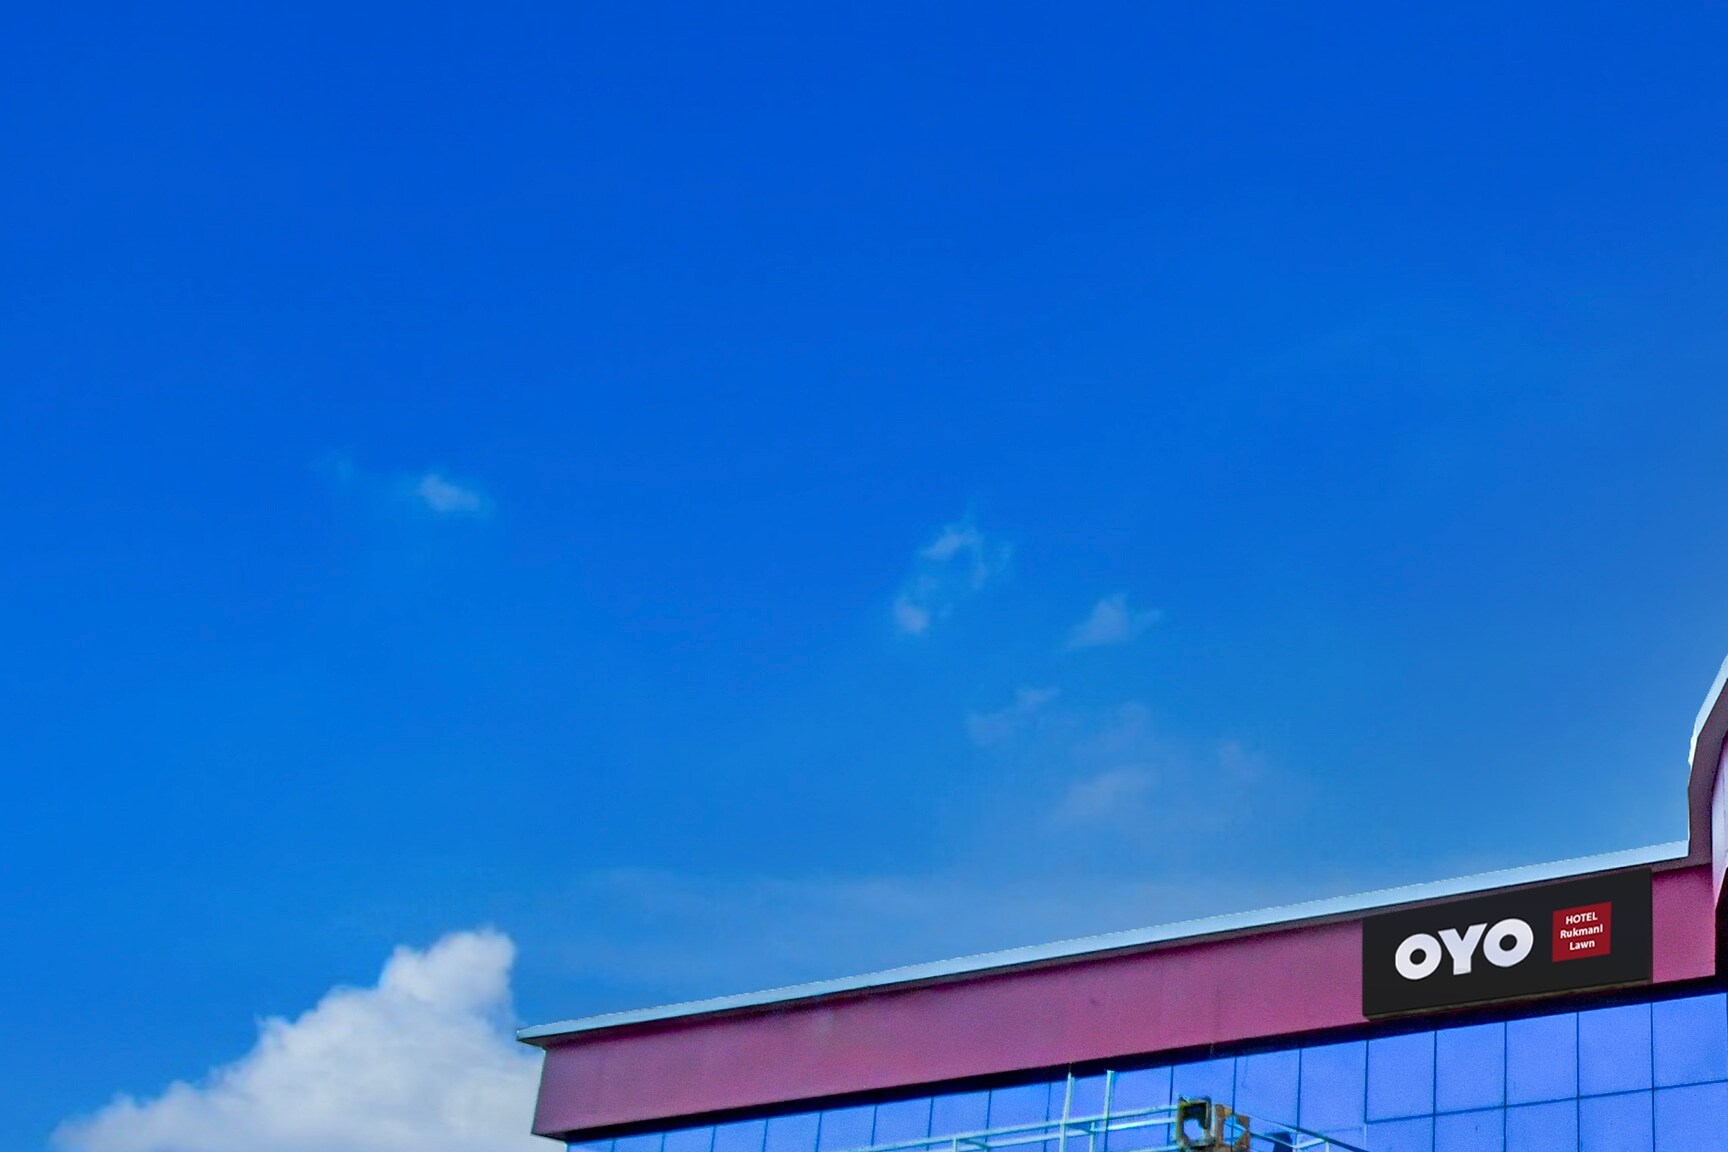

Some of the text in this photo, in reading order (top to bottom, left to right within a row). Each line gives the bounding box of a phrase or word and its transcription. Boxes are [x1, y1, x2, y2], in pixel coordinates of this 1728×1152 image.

[1565, 911, 1598, 925] HOTEL
[1394, 918, 1534, 980] OYO
[1569, 940, 1596, 951] Lawn
